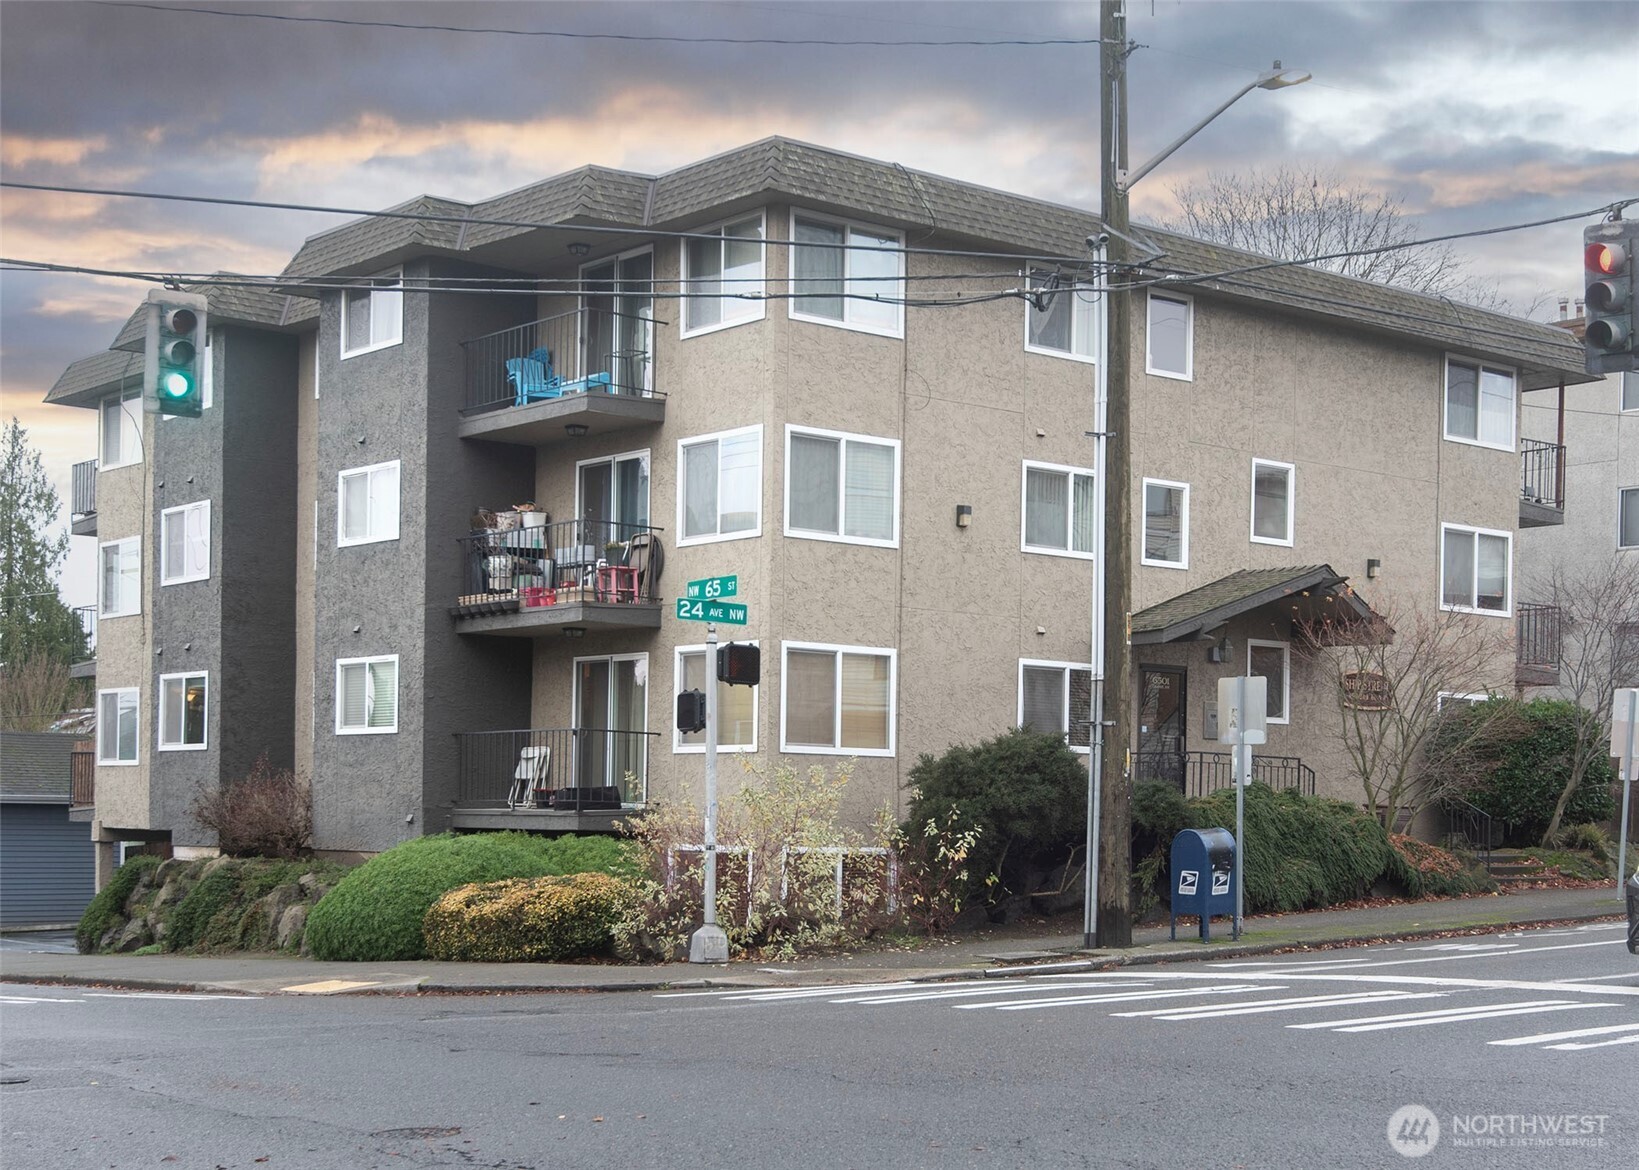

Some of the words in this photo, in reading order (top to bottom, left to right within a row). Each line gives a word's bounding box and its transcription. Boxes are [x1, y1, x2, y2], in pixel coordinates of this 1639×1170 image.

[688, 585, 699, 597] NW
[705, 580, 721, 597] 65
[727, 581, 735, 590] ST
[679, 600, 704, 618] 24
[709, 608, 723, 617] AVE
[729, 609, 744, 620] NW
[1152, 676, 1170, 685] 6501
